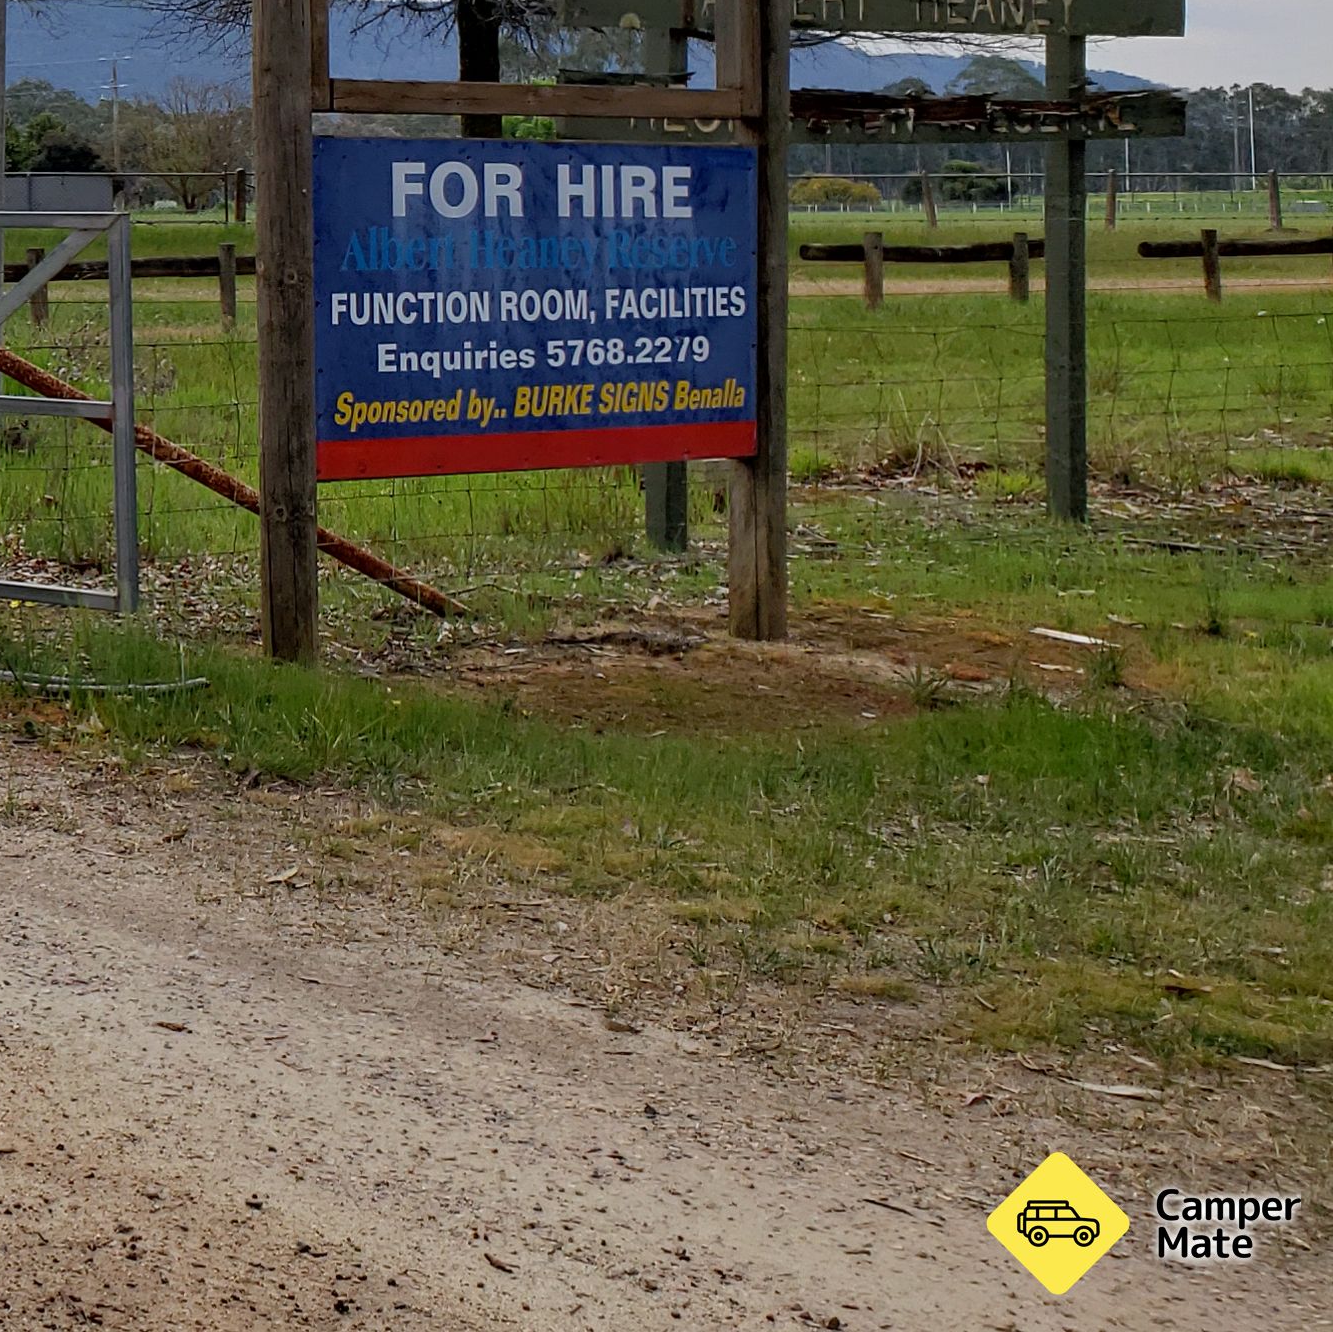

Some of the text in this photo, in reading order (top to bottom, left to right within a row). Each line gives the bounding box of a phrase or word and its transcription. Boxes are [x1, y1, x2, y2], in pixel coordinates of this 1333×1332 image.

[391, 161, 693, 219] FOR HIRE
[340, 225, 738, 280] Albert Heaney Reserve
[331, 285, 746, 326] FUNCTION ROOM, FACILITIES
[377, 335, 710, 379] Enquiries 5768.2279
[334, 388, 463, 432] Sponsored
[514, 383, 595, 418] BURKE
[598, 380, 669, 414] SIGNS
[674, 377, 745, 410] Benalla
